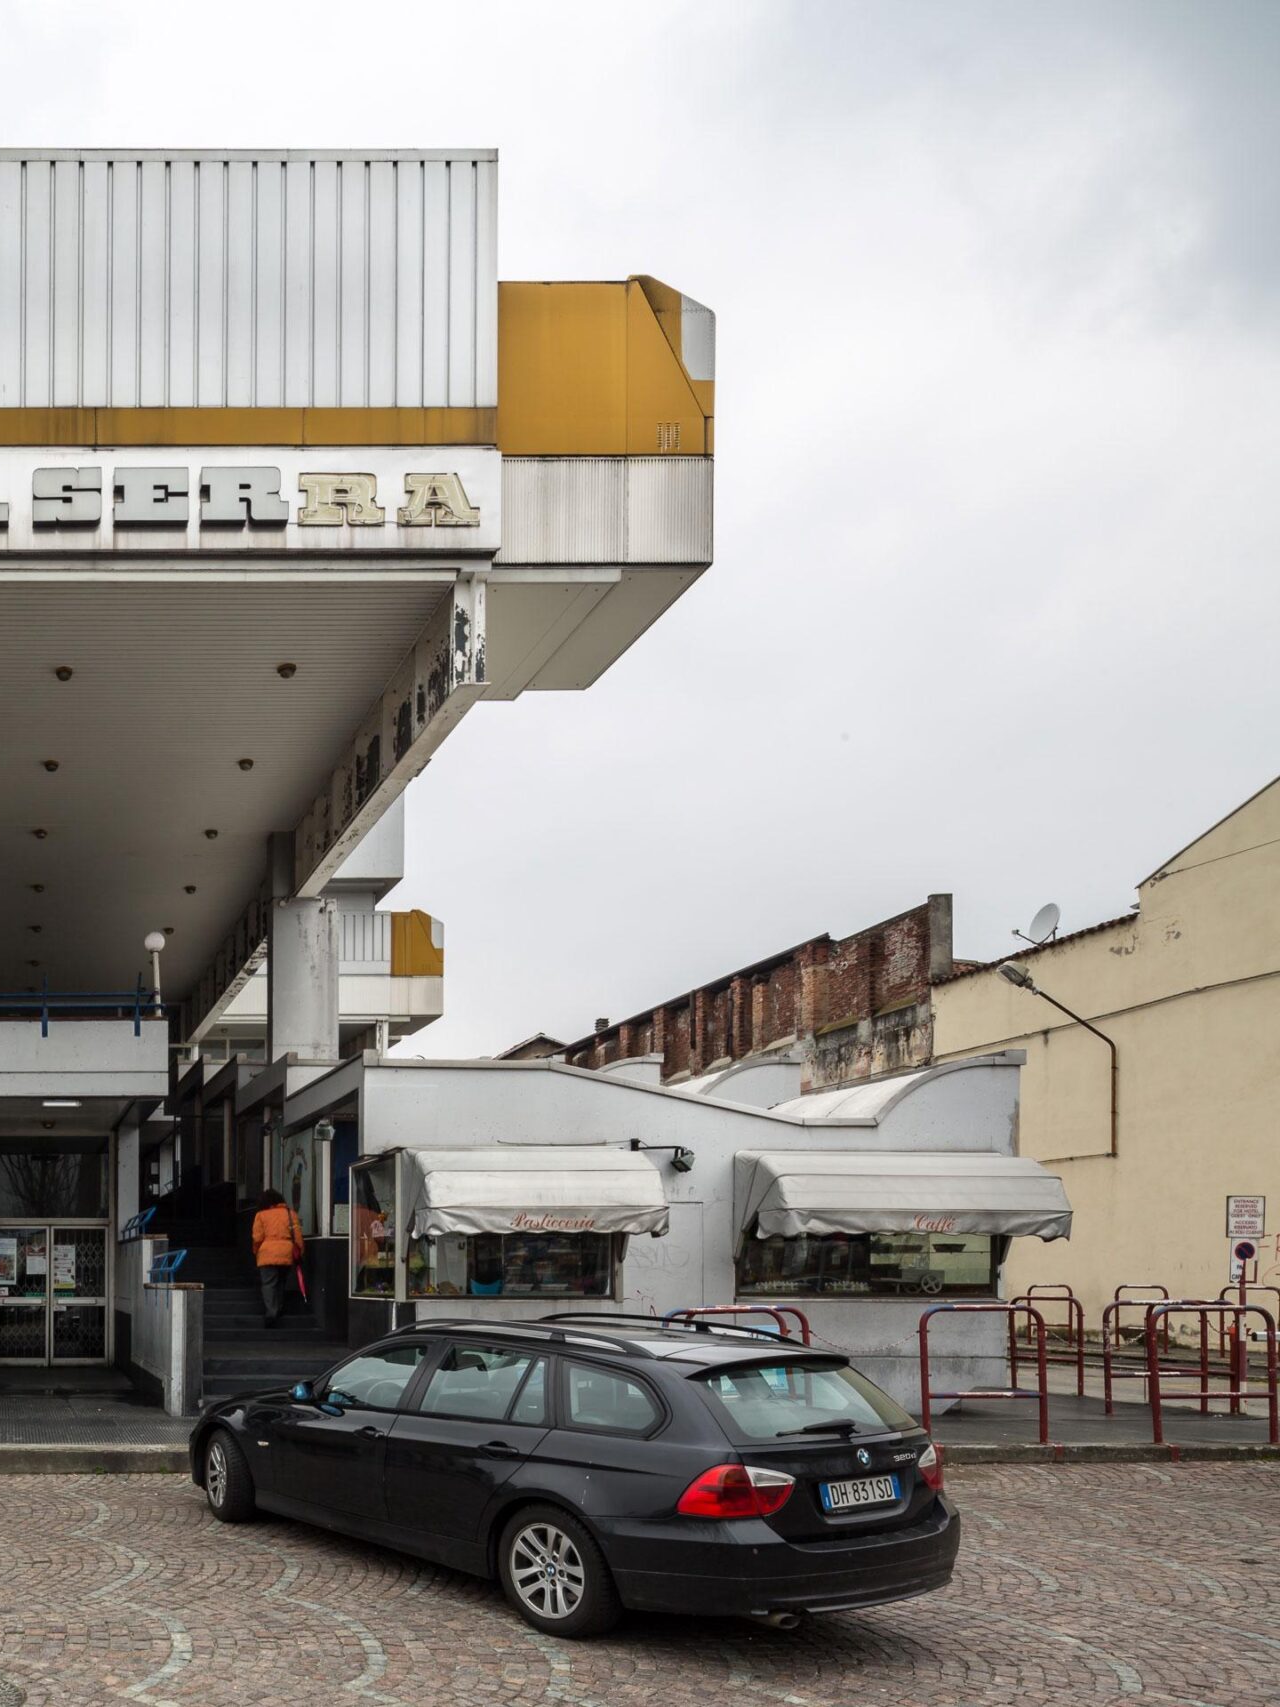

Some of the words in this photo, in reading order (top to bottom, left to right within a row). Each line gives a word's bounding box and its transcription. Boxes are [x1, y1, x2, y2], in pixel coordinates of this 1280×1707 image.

[32, 466, 480, 529] SERRA
[510, 1210, 595, 1229] Pasticceria
[893, 1452, 917, 1462] 320d
